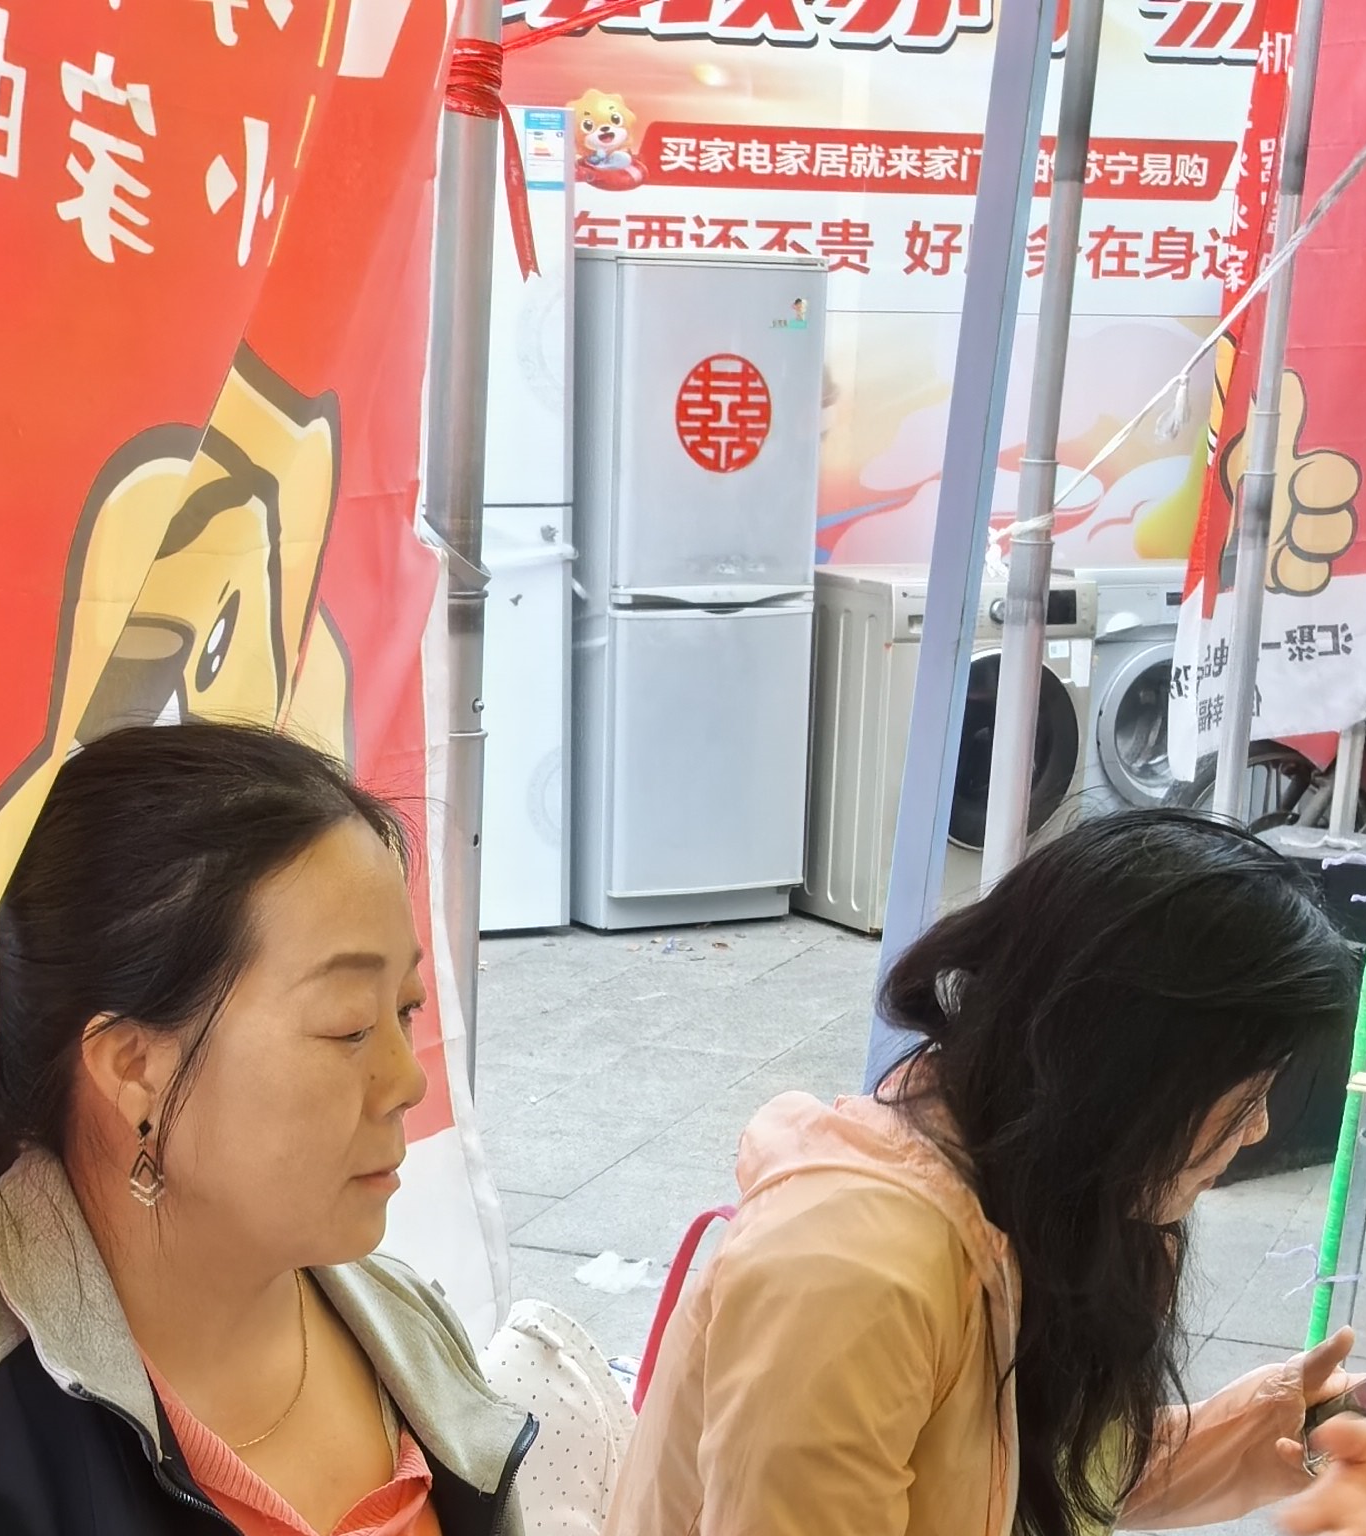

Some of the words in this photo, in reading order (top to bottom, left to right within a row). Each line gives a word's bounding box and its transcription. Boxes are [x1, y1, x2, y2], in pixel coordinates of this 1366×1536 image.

[661, 136, 1209, 188] 买家电家居就来家门的苏宁易购
